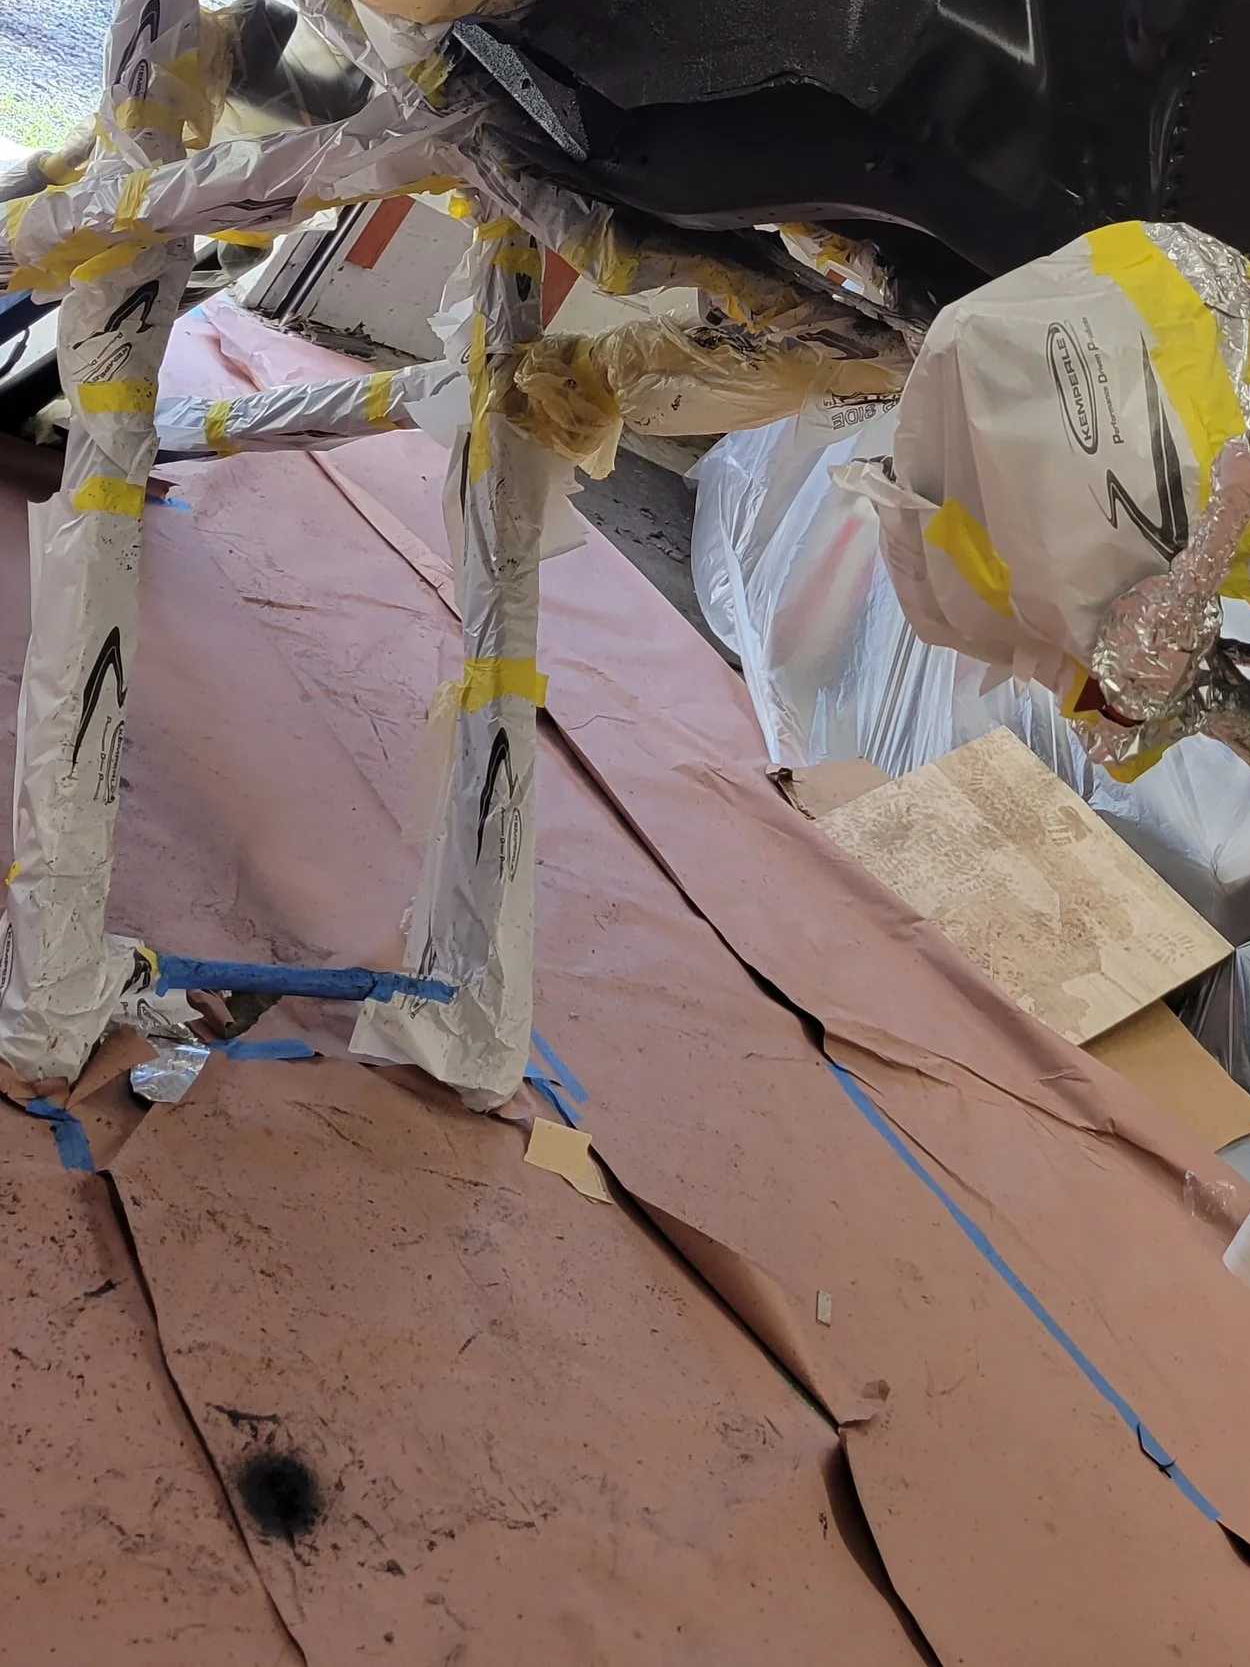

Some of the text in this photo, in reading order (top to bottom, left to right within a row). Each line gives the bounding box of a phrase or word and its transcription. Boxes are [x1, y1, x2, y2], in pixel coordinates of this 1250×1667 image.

[1056, 336, 1092, 442] KEMPERLE
[1094, 353, 1108, 384] Driven
[1103, 386, 1125, 445] Performance
